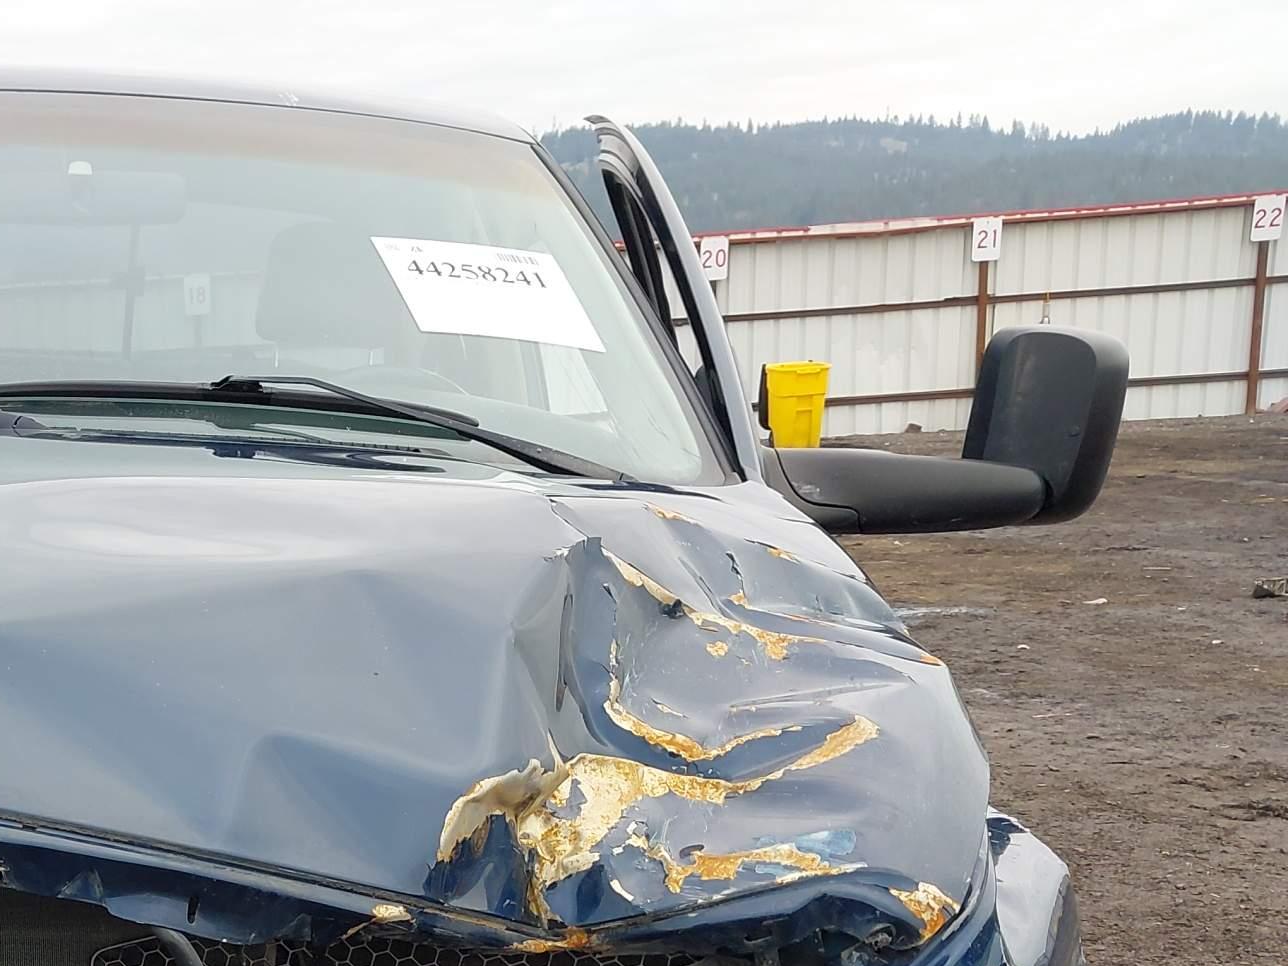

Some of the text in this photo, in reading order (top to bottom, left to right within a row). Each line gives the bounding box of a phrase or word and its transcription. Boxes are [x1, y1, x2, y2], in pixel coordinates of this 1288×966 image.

[1254, 207, 1282, 229] 22
[977, 229, 997, 249] 21
[702, 248, 727, 269] 20
[407, 259, 548, 289] 44258241
